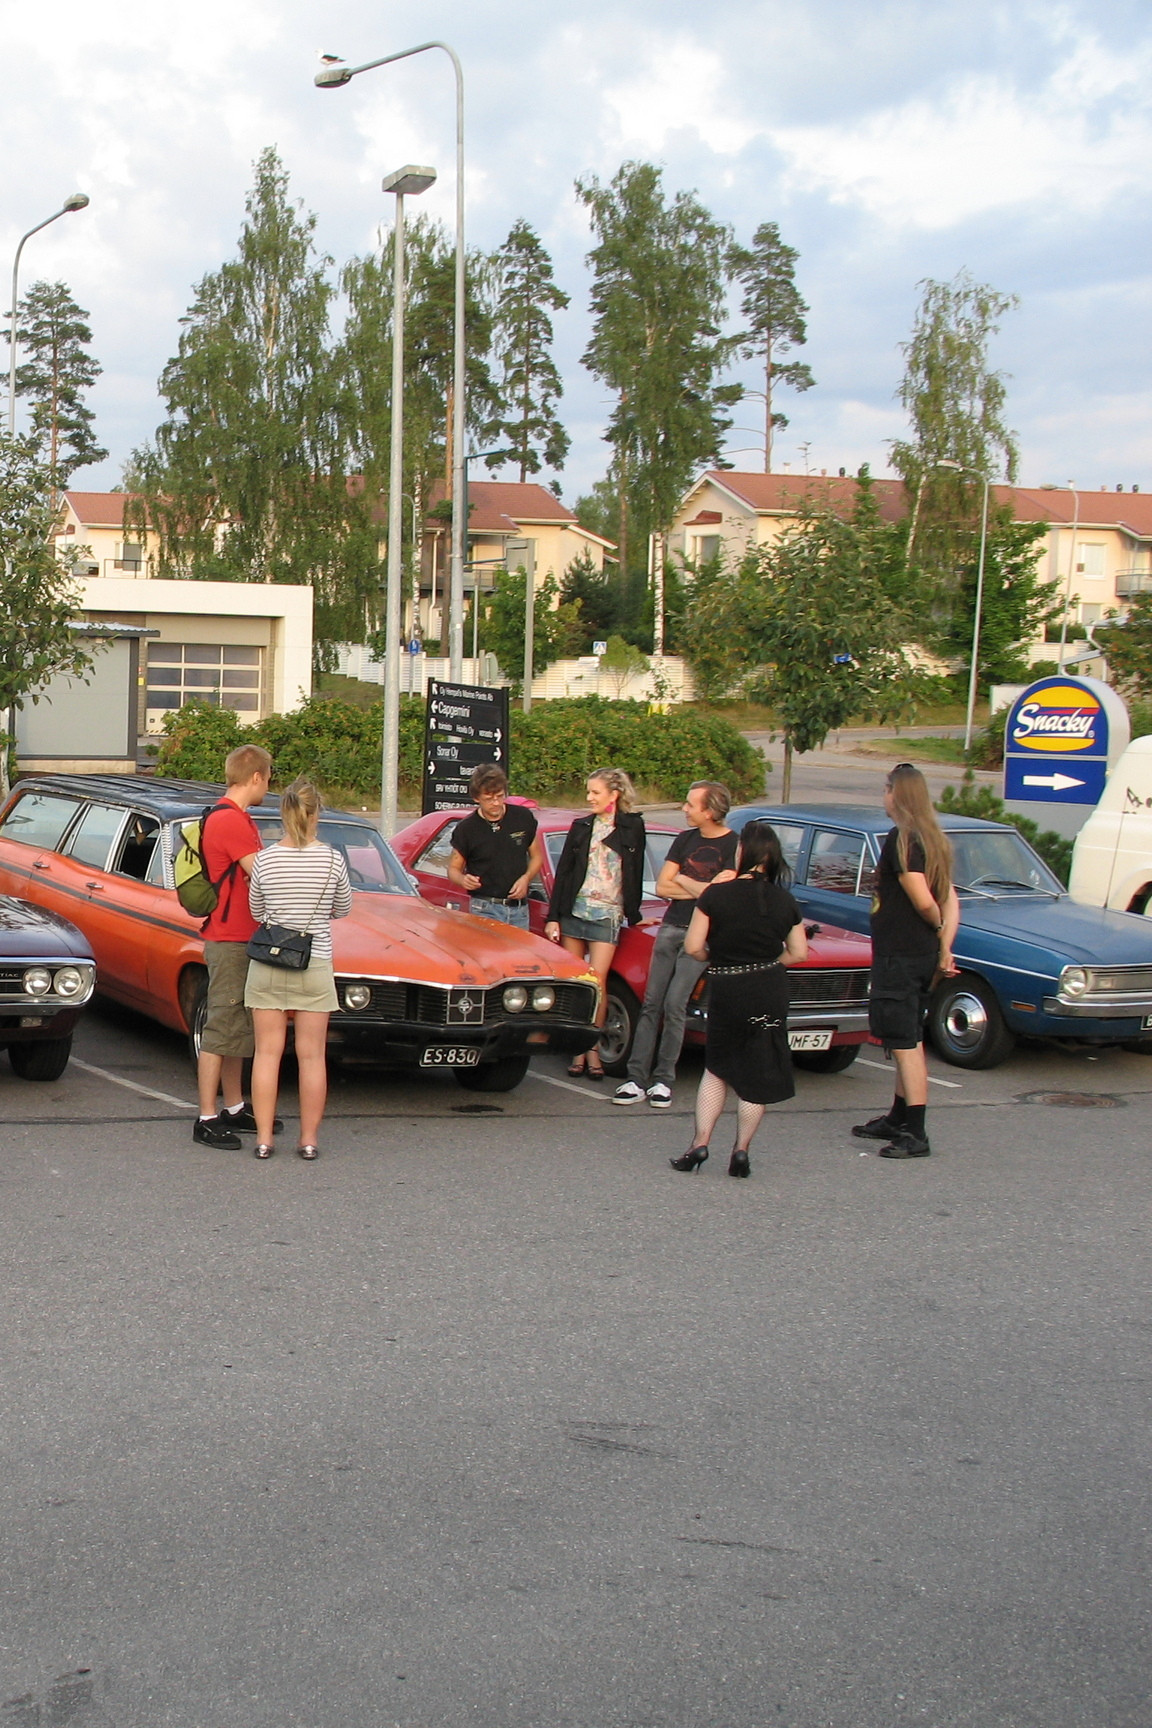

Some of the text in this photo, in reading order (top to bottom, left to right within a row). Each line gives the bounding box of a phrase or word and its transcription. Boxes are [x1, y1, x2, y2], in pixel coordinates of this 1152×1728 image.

[438, 701, 471, 718] Capgemini
[1013, 703, 1094, 738] Snacky
[423, 1048, 476, 1064] ES-830
